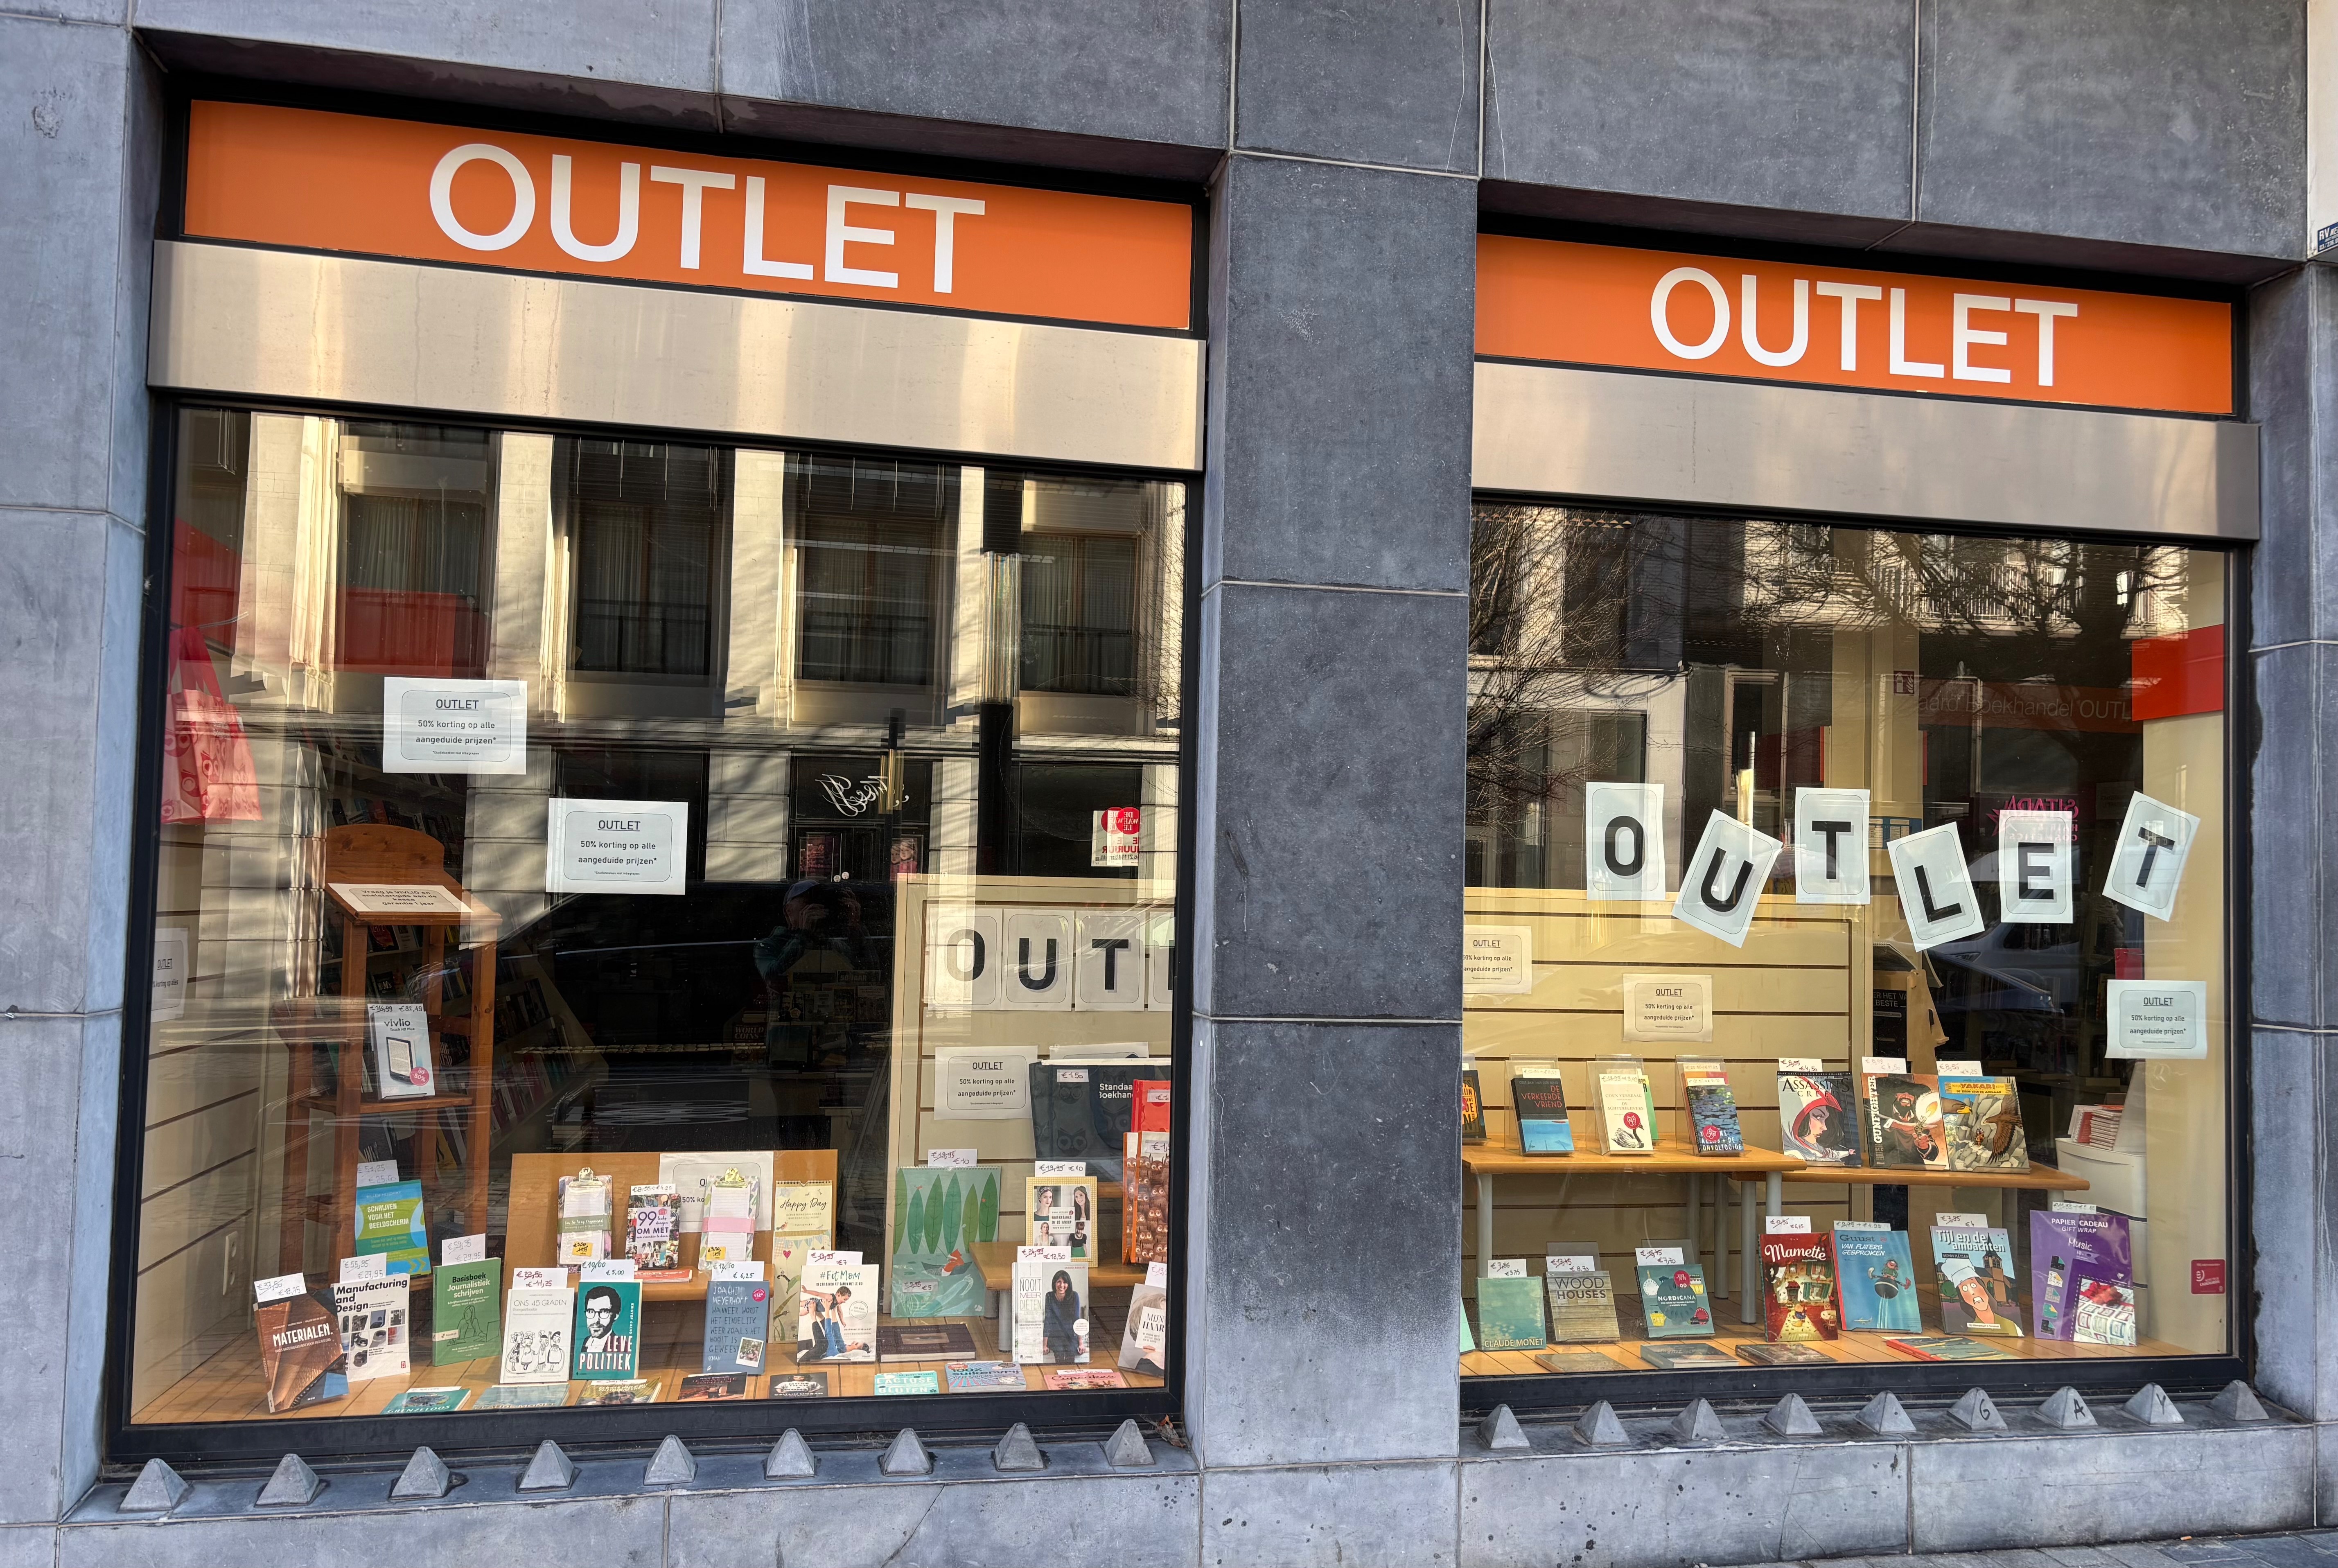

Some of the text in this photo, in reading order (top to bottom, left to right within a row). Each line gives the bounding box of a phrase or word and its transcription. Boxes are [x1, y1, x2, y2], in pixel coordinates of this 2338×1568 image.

[430, 143, 985, 293] OUTLET
[1650, 267, 2078, 387] OUTLET
[436, 699, 479, 710] OUTLET
[437, 720, 465, 729] korting
[599, 820, 641, 830] OUTLET
[599, 842, 627, 850] korting
[2143, 997, 2173, 1005] OUTLET
[384, 1018, 411, 1027] vivlio
[1867, 1075, 1882, 1144] GUNFIGHTER
[367, 1203, 397, 1213] SCHRIJVEN
[780, 1198, 828, 1212] Happy Day
[369, 1218, 409, 1229] BEELDSCHERM
[638, 1211, 657, 1226] 99
[1936, 1230, 1986, 1244] Tijl en de
[1952, 1241, 2005, 1252] ambachten
[2068, 1238, 2092, 1251] Music
[1765, 1243, 1826, 1262] Mamette
[452, 1272, 486, 1283] Basisboek
[1555, 1277, 1604, 1289] WOOD
[336, 1279, 407, 1295] Manufacturing
[447, 1279, 490, 1292] Journalistiek
[1020, 1279, 1041, 1291] NOOIT
[336, 1293, 355, 1304] and
[454, 1288, 483, 1298] schrijven
[1557, 1290, 1606, 1299] HOUSES
[713, 1296, 748, 1305] MEYERHOFF
[336, 1302, 368, 1312] Design
[1143, 1321, 1164, 1332] HAAR
[273, 1323, 333, 1347] MATERIALEN.
[607, 1336, 632, 1352] LEVE
[1516, 1338, 1544, 1346] MONET
[578, 1353, 632, 1370] POLITIEK
[1979, 1393, 2166, 1421] G A Y
